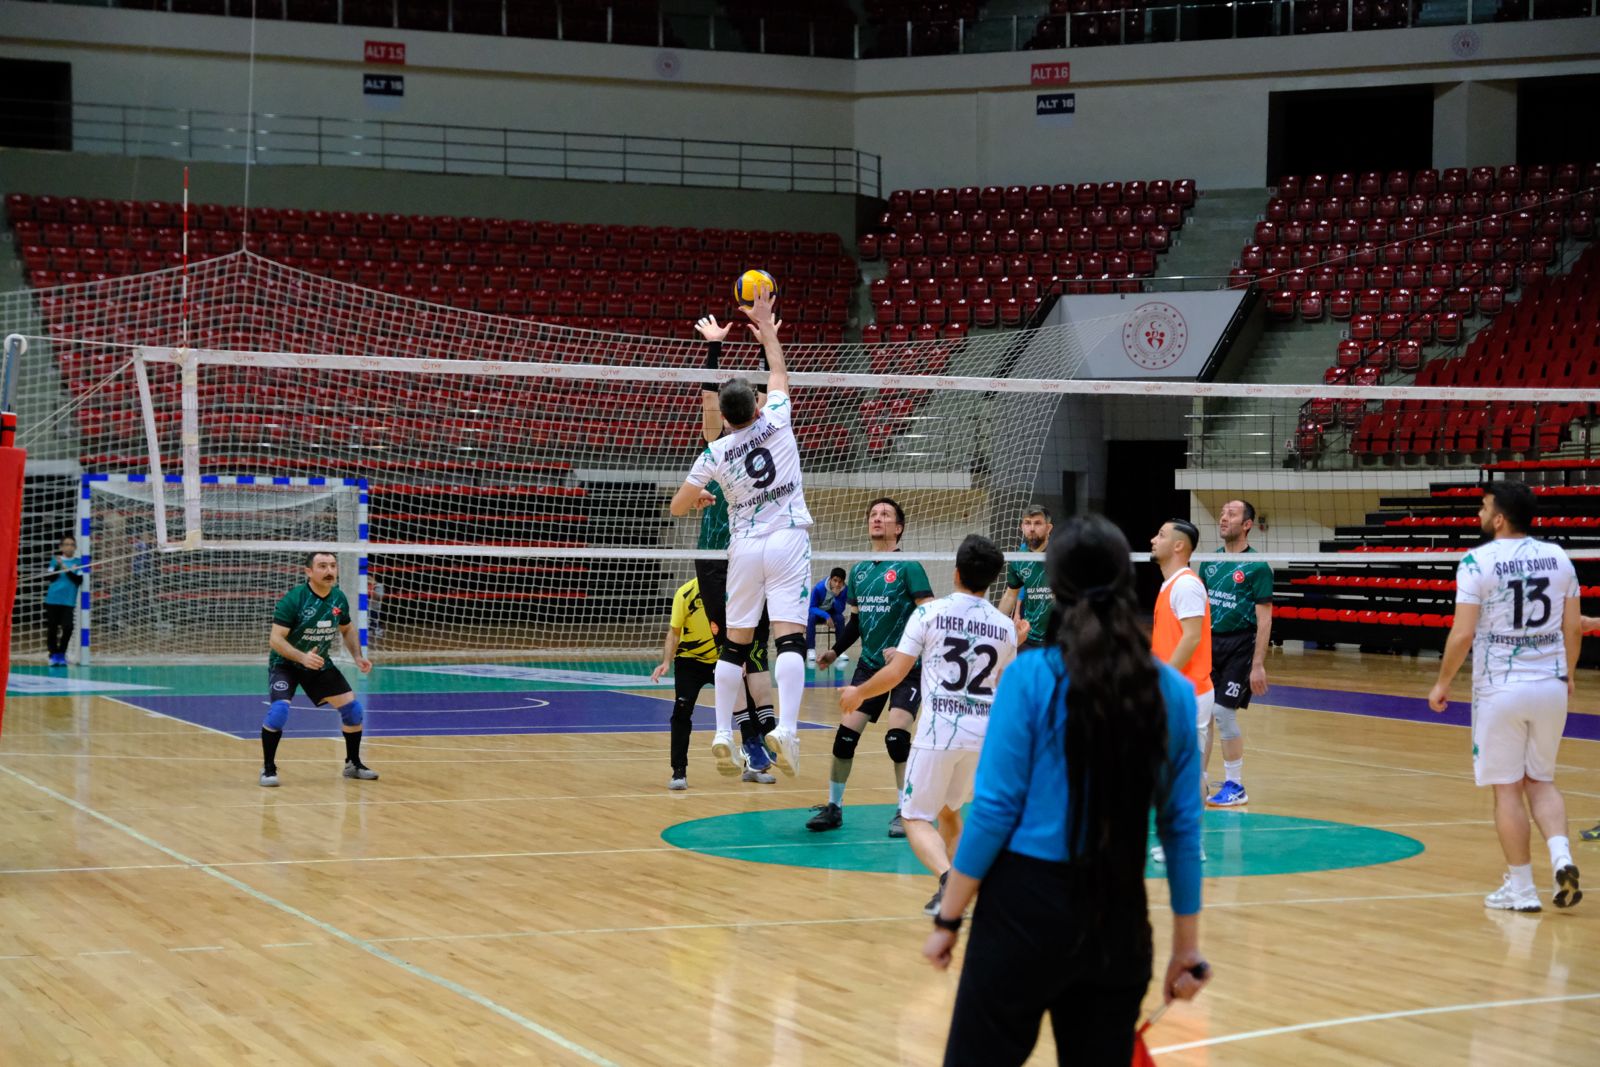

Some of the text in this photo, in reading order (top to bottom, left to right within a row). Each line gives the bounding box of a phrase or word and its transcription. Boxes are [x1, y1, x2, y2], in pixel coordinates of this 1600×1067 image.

[367, 45, 385, 58] ALT
[1033, 66, 1069, 80] ALT 16
[365, 80, 385, 89] ALT
[1038, 100, 1059, 109] ALT
[744, 447, 776, 489] 9
[1527, 557, 1559, 572] SAVUR
[866, 595, 889, 603] VARSA
[1222, 601, 1237, 609] VAR
[1507, 577, 1551, 629] 13
[936, 613, 1008, 642] İLKER AKBULUT
[940, 636, 998, 696] 32
[909, 687, 917, 702] 7
[1225, 681, 1240, 698] 26
